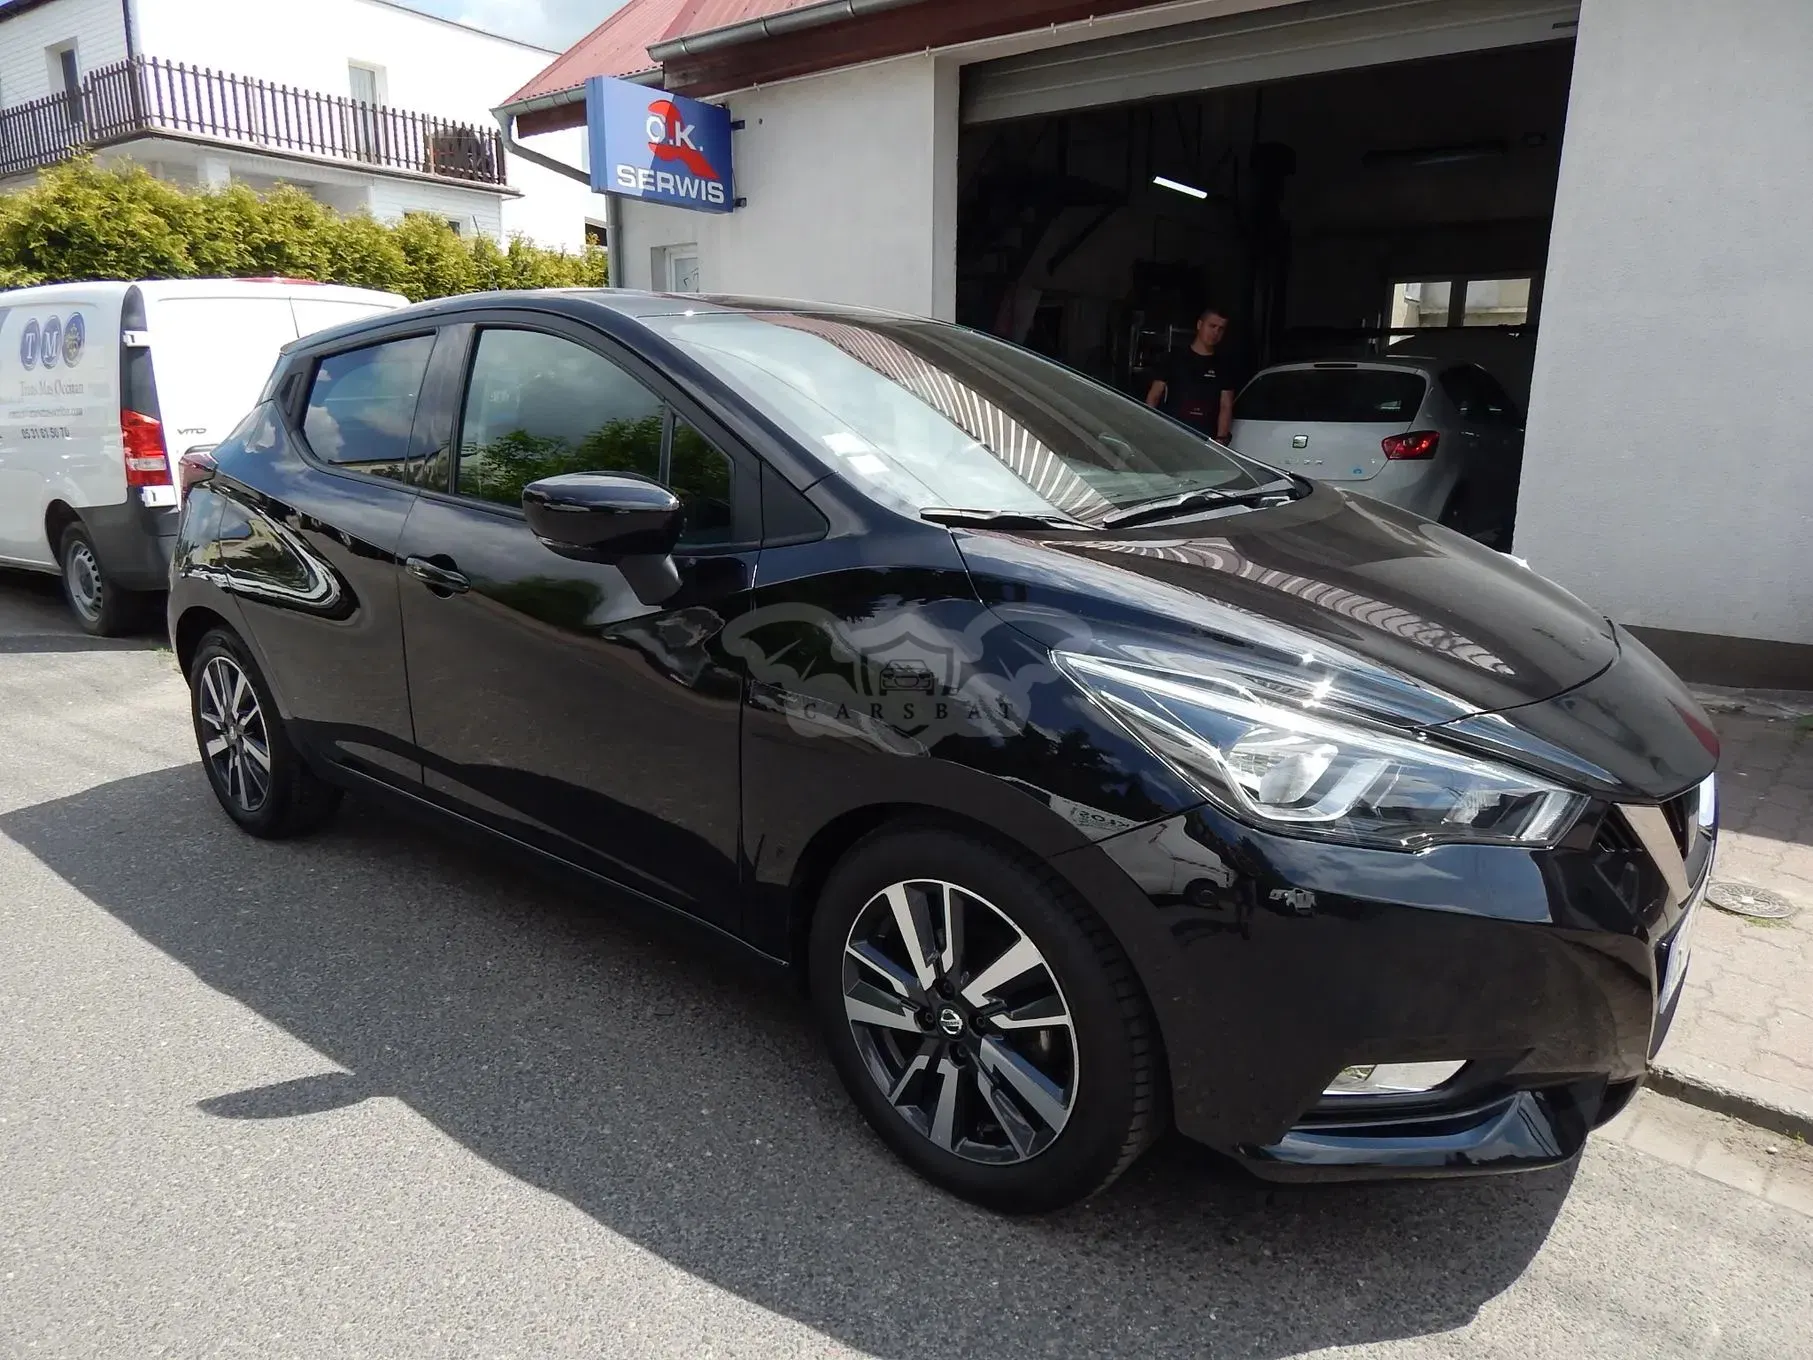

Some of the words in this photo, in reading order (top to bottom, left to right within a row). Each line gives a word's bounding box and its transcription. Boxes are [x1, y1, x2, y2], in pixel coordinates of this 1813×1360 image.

[646, 115, 704, 152] O.K.
[616, 163, 725, 204] SERWIS
[176, 427, 207, 435] VITO
